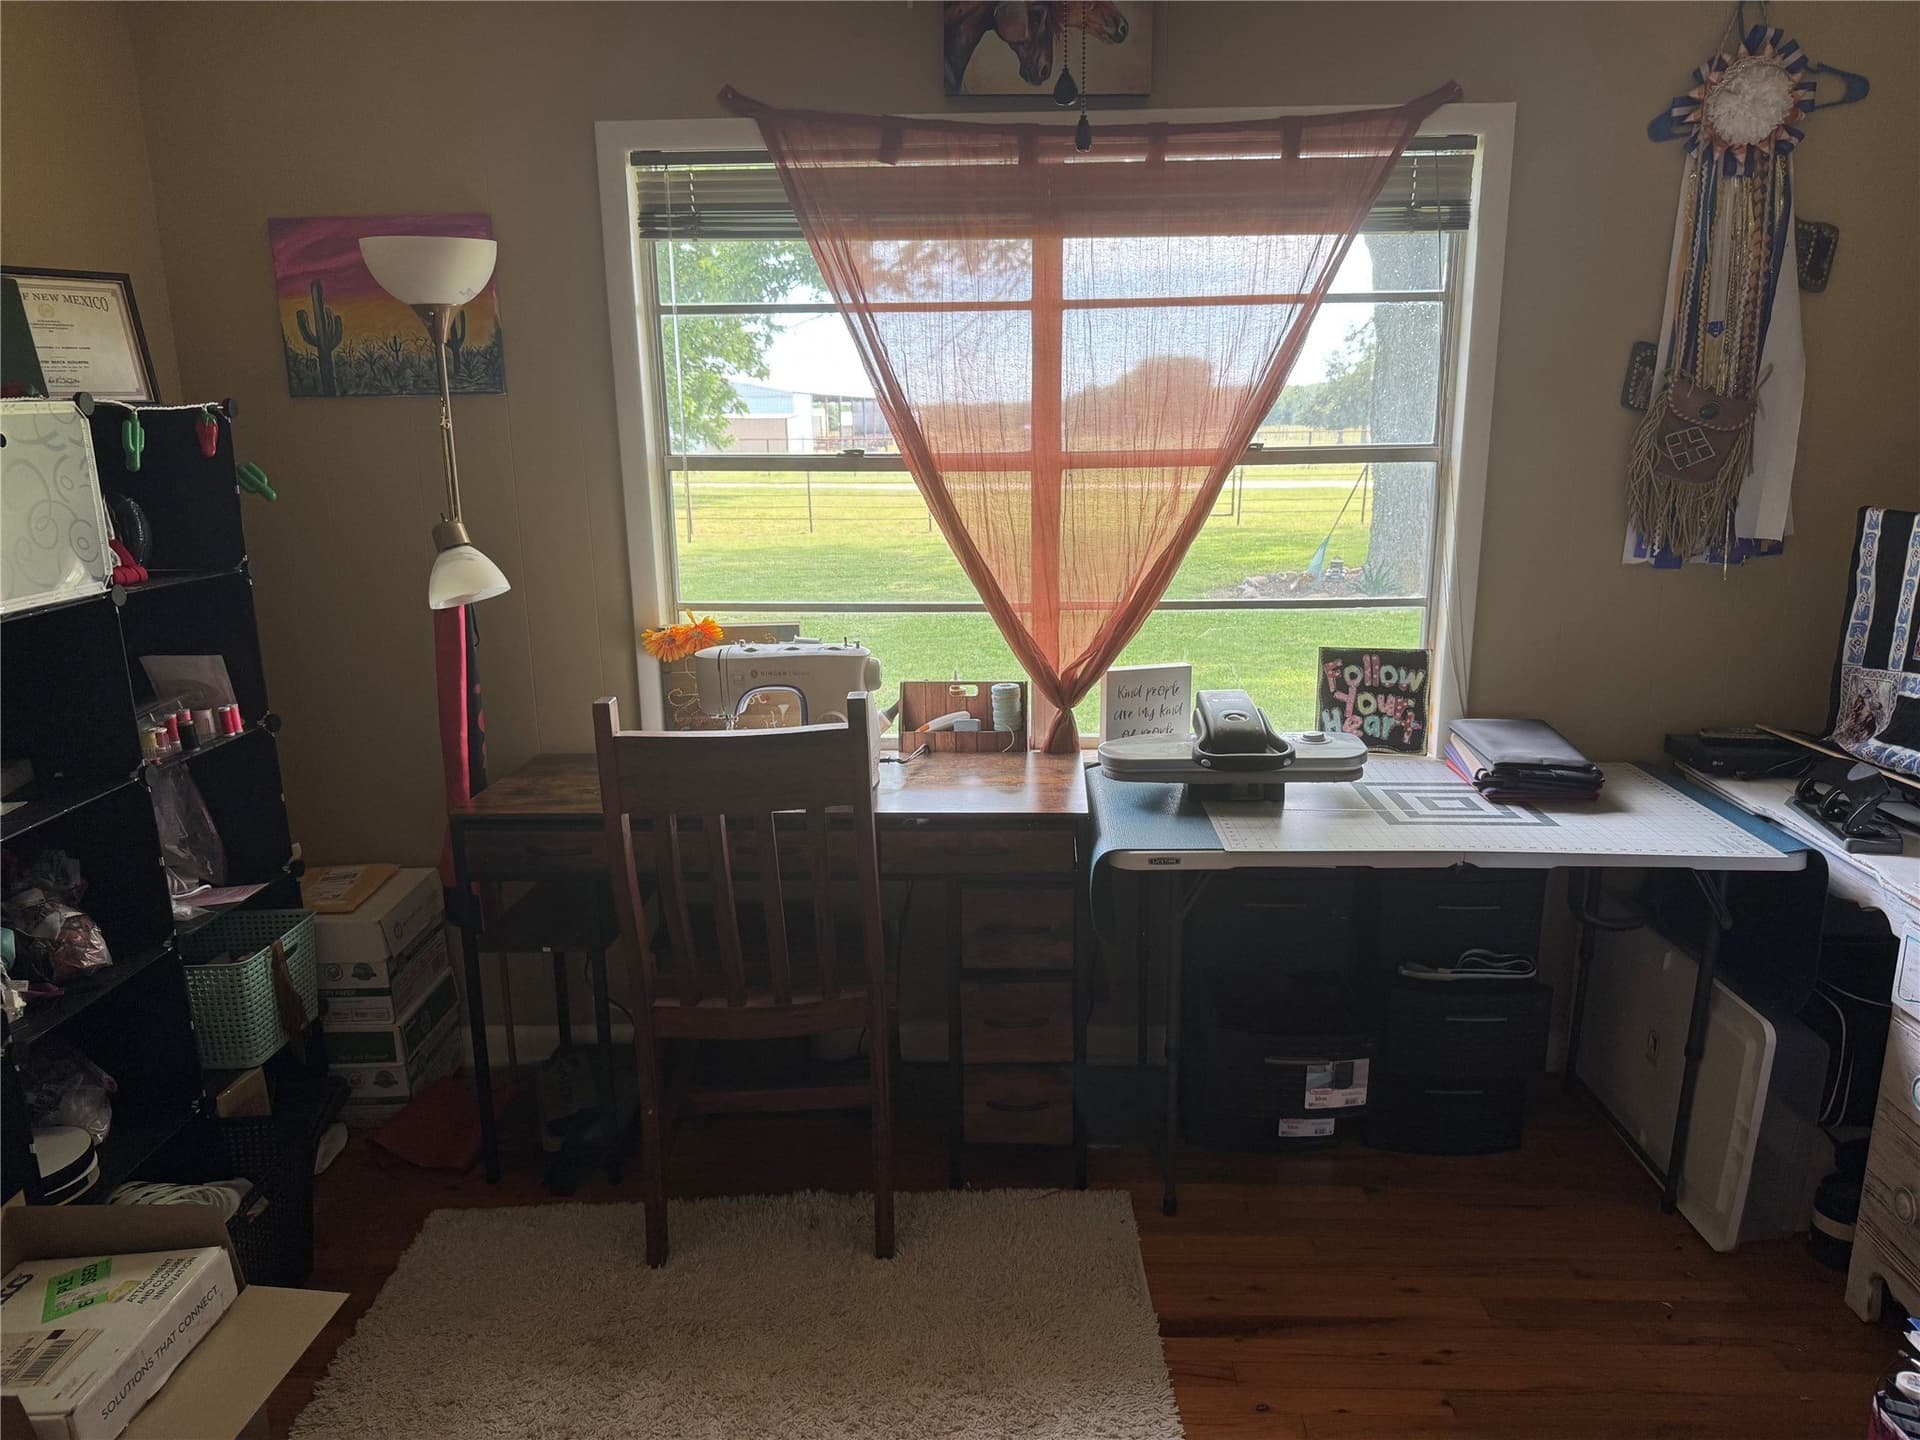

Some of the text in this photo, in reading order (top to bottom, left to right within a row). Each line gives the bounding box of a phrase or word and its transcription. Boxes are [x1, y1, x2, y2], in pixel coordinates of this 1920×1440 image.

[32, 292, 59, 302] NEW
[62, 294, 109, 312] MEXICO
[1323, 654, 1425, 692] Follow
[1117, 680, 1180, 702] Kind people
[127, 1258, 173, 1302] ATTACHMENT
[137, 1289, 154, 1304] AND
[101, 1284, 219, 1420] SOLUTIONS THAT CONNECT
